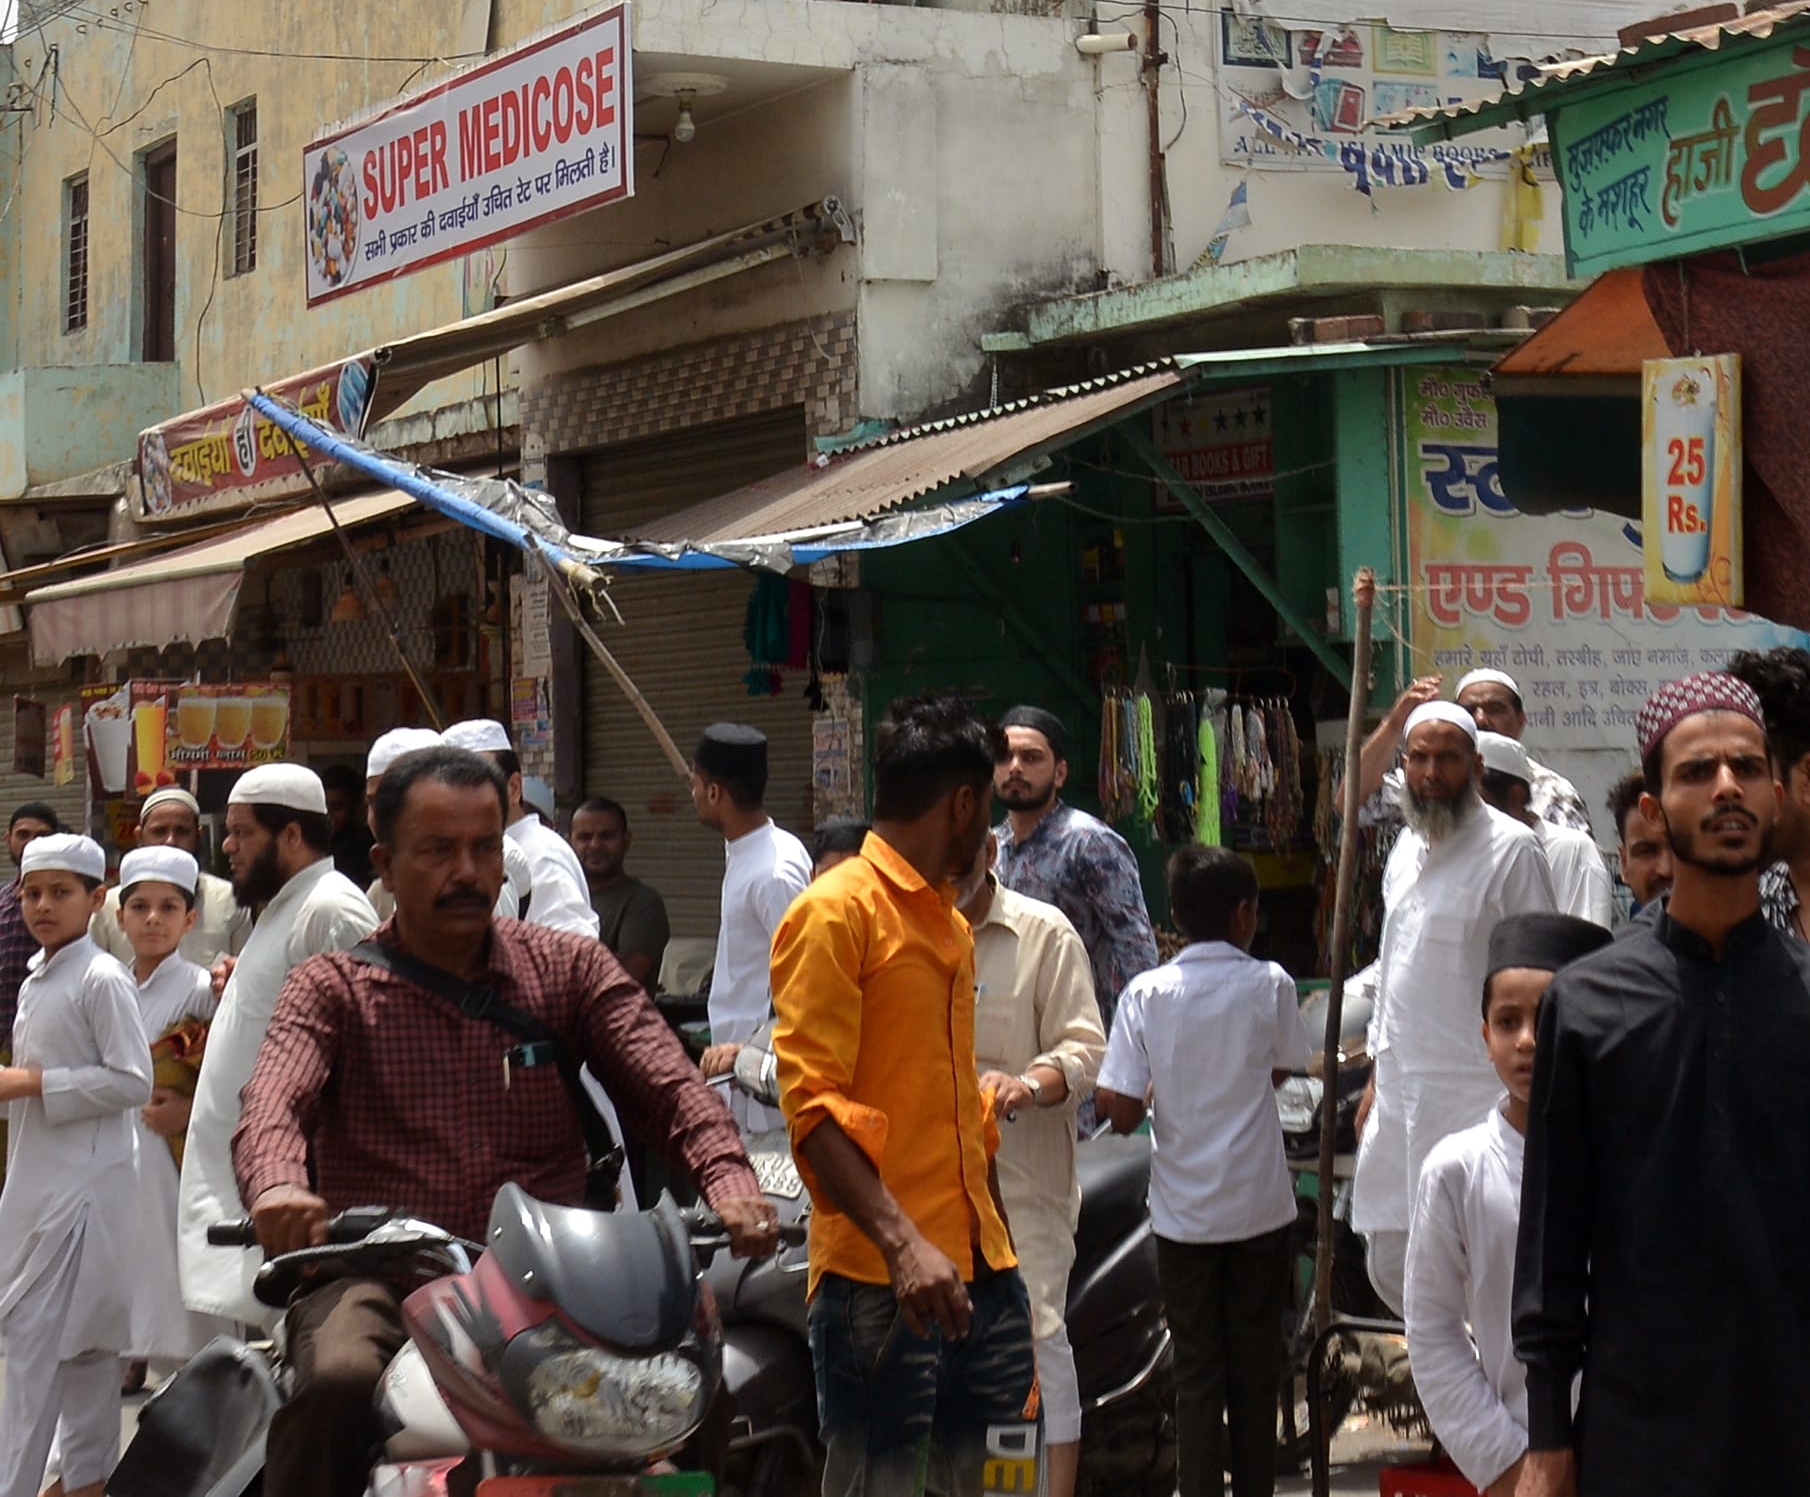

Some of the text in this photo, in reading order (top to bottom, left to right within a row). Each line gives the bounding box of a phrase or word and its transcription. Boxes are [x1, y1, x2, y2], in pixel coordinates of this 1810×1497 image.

[362, 46, 615, 221] SUPER MEDICOSE
[1662, 97, 1740, 226] हाजी
[364, 228, 386, 261] सभी
[389, 220, 417, 254] प्रकार
[420, 209, 435, 241] की
[439, 192, 480, 232] दवाईयाँ
[482, 184, 512, 218] उचित
[516, 177, 532, 205] रेट
[535, 174, 551, 197] पर
[555, 147, 595, 191] मिलती
[1597, 165, 1652, 232] मशहूर
[1667, 438, 1706, 486] 25
[1667, 494, 1707, 534] Rs.
[1425, 564, 1534, 625] एण्ड
[1433, 644, 1473, 667] हमारे
[1480, 644, 1508, 667] यहाँ
[1512, 643, 1550, 669] टोपी,
[1531, 679, 1571, 699] रहल,
[1562, 704, 1597, 728] आदि
